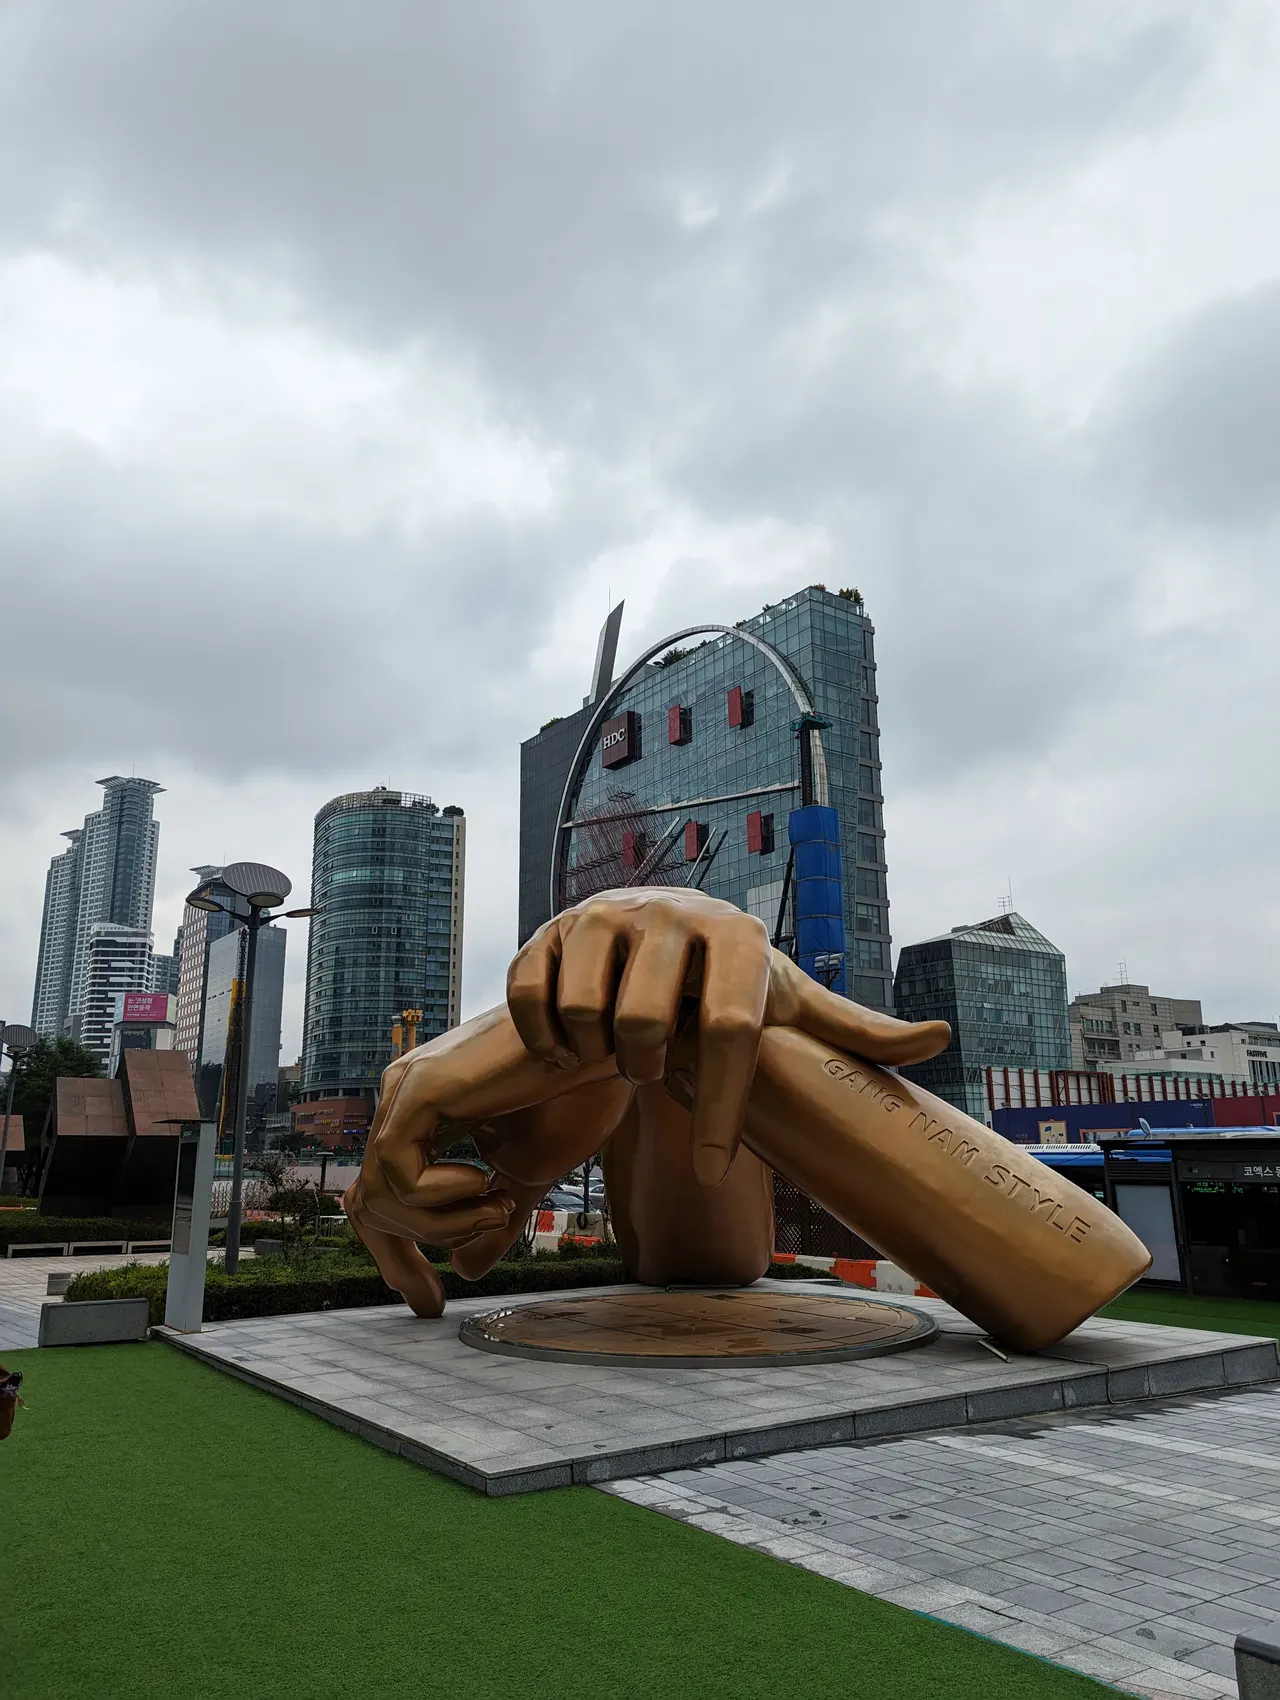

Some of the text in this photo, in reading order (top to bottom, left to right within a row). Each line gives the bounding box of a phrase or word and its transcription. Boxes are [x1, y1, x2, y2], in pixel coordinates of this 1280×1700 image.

[603, 728, 625, 749] HDC
[1246, 1049, 1268, 1058] FASTFIVE
[822, 1058, 1092, 1244] GANG NAM STYLE
[1244, 1166, 1274, 1178] 코엑스
